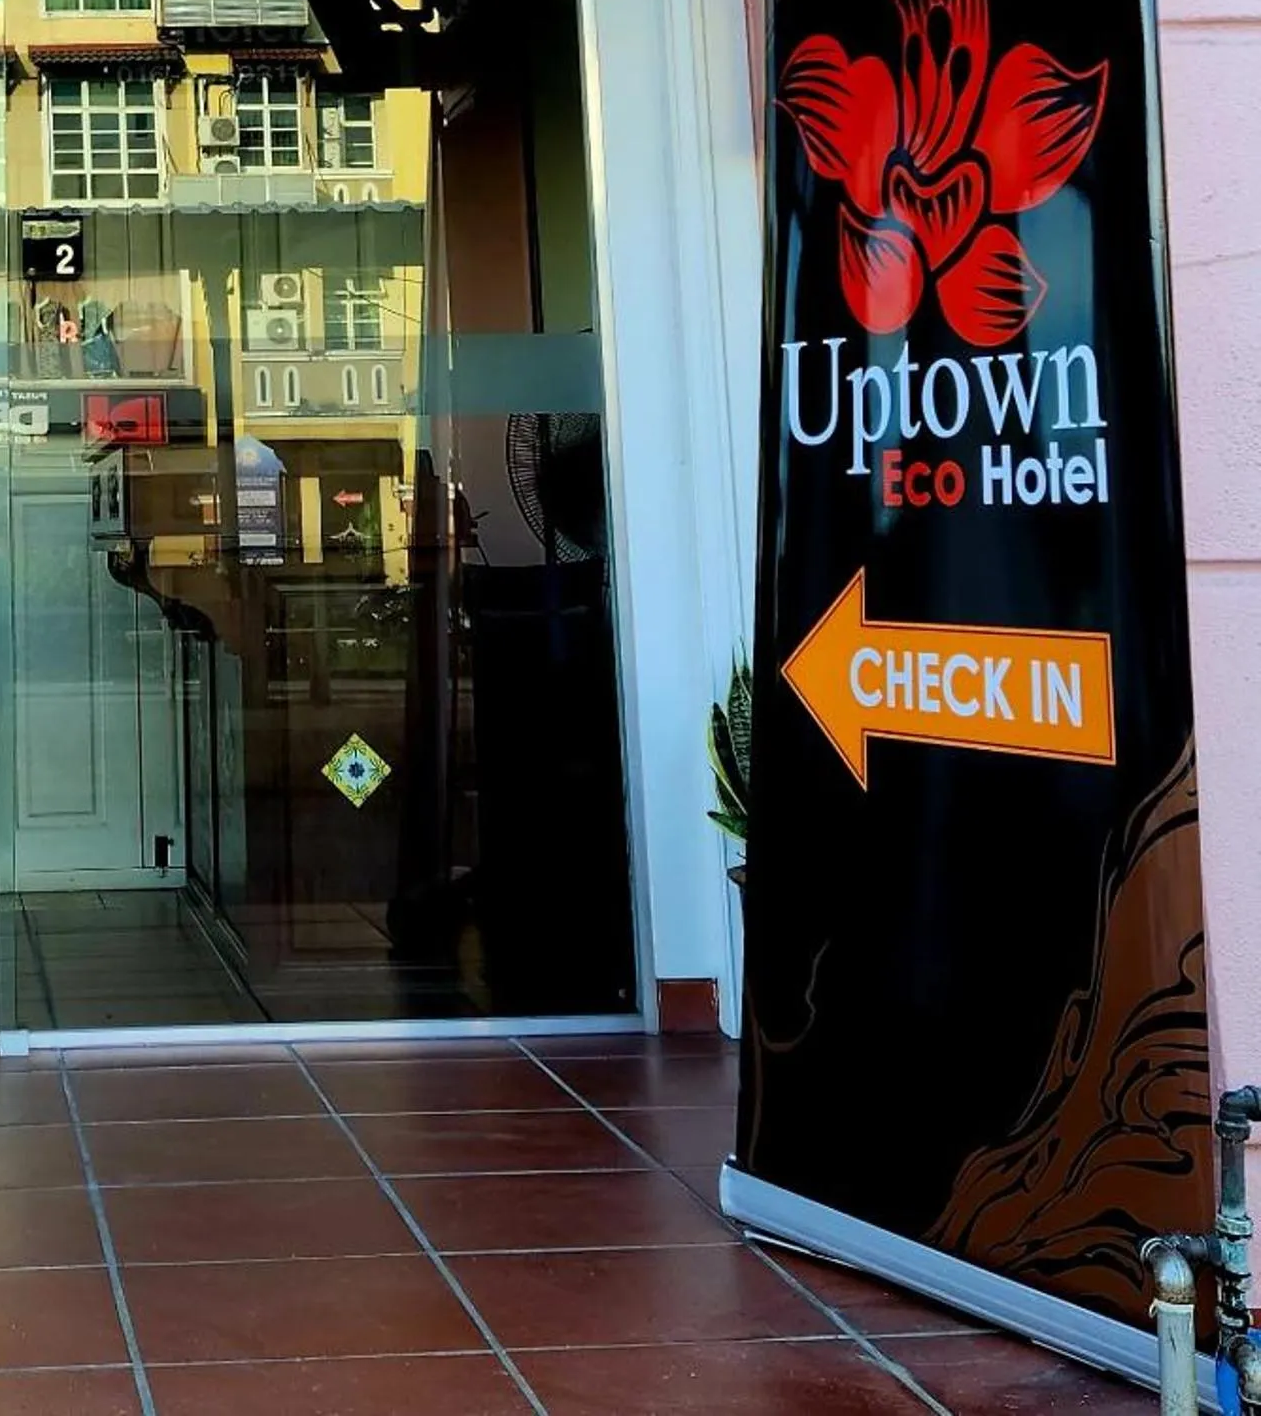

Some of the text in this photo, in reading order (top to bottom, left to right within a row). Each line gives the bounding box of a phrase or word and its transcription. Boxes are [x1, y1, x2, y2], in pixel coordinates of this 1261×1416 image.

[55, 243, 75, 275] 2
[781, 338, 1108, 475] Uptown
[881, 438, 1108, 507] Eco Hotel
[850, 647, 1083, 728] CHECK IN
